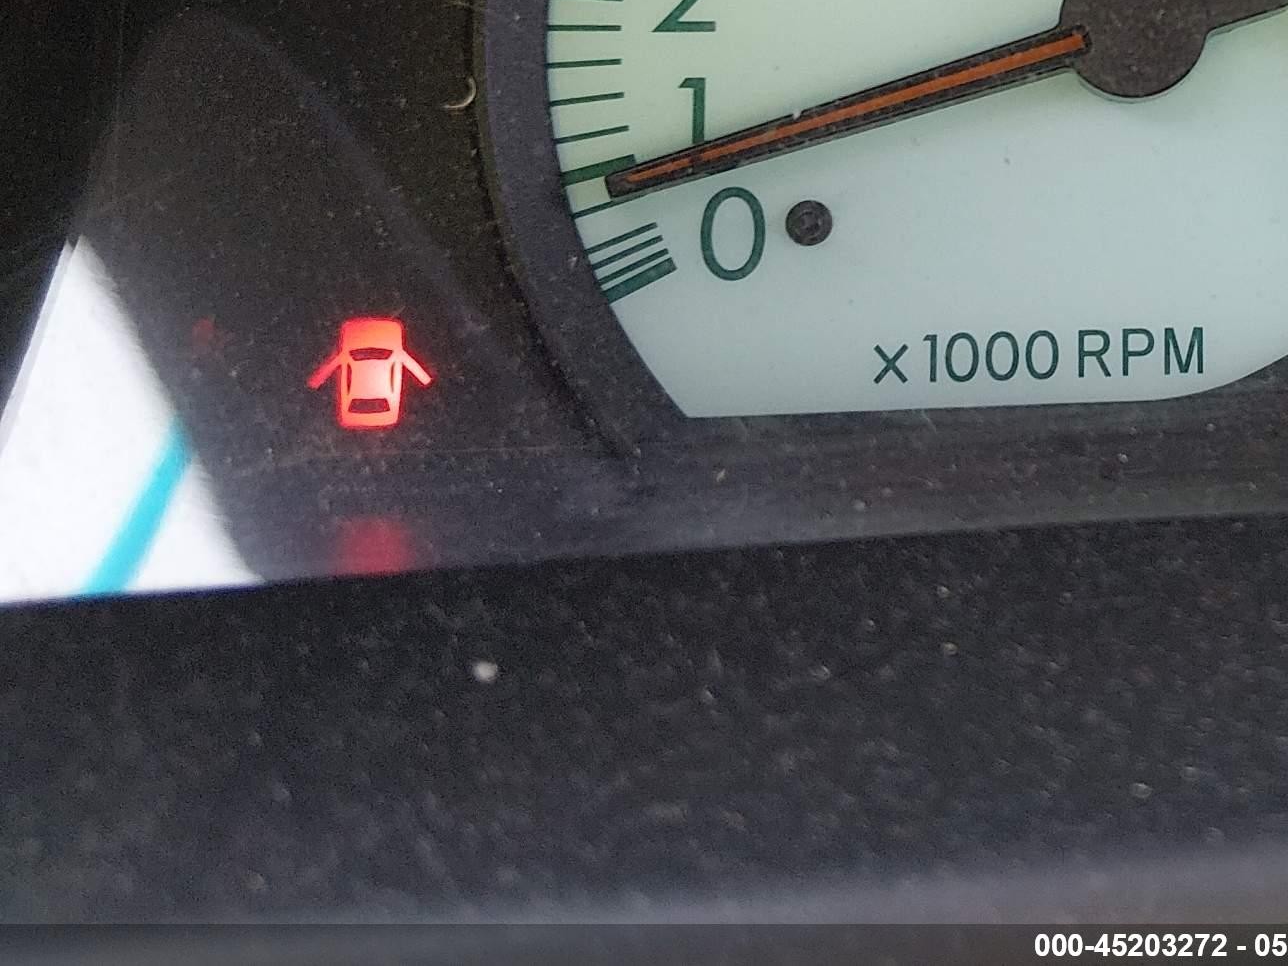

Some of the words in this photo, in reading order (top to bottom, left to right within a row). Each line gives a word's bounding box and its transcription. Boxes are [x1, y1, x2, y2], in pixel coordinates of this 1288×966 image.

[677, 77, 707, 145] 1
[699, 186, 766, 282] 0
[1077, 326, 1206, 379] RPM
